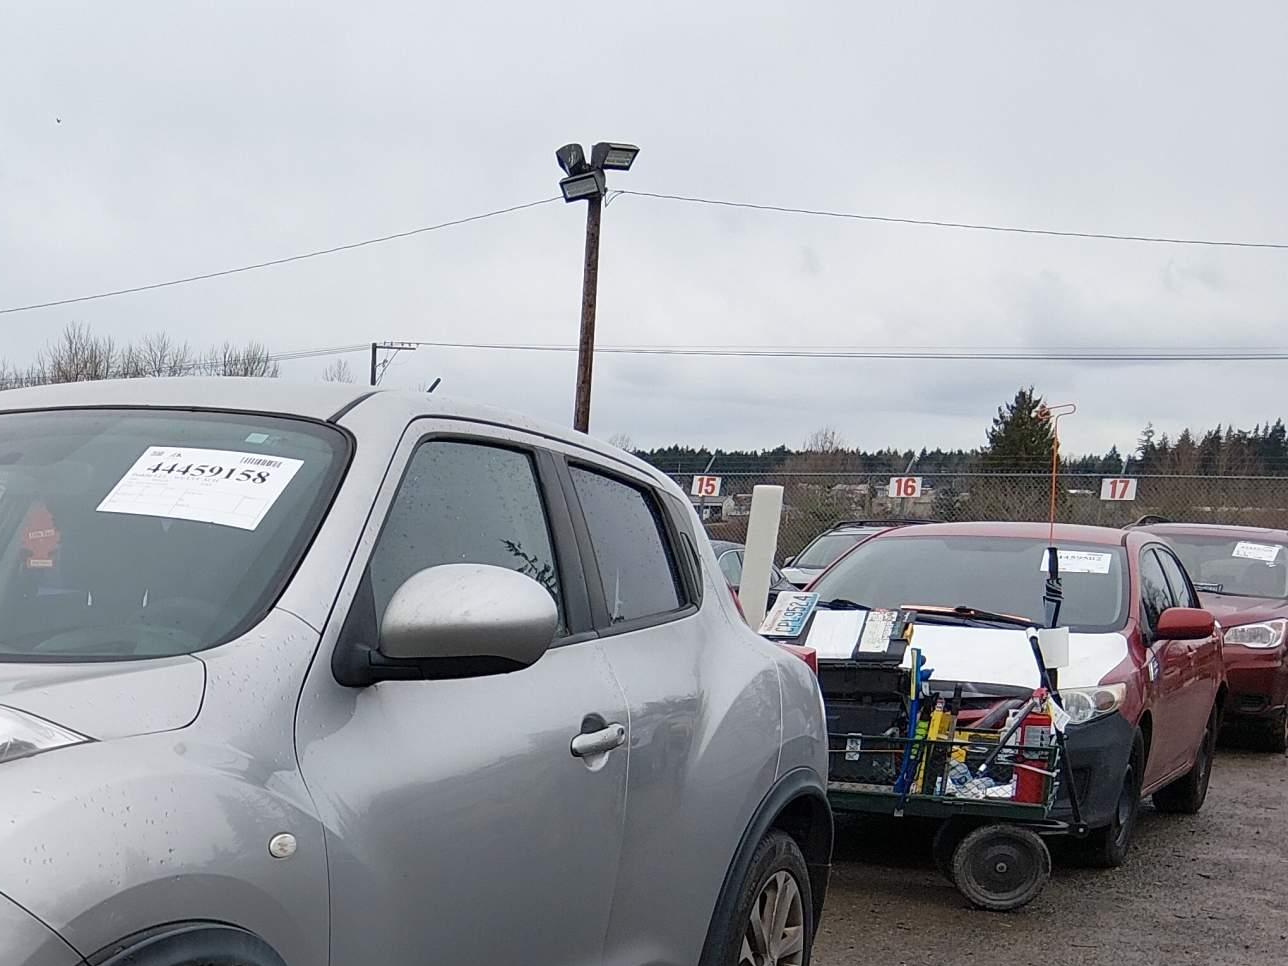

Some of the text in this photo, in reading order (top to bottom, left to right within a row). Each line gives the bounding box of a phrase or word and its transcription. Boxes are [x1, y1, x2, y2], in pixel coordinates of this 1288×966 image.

[146, 462, 271, 485] 44459158
[697, 476, 717, 495] 15
[895, 478, 917, 497] 16
[1110, 479, 1130, 499] 17
[775, 595, 815, 633] CPL9524
